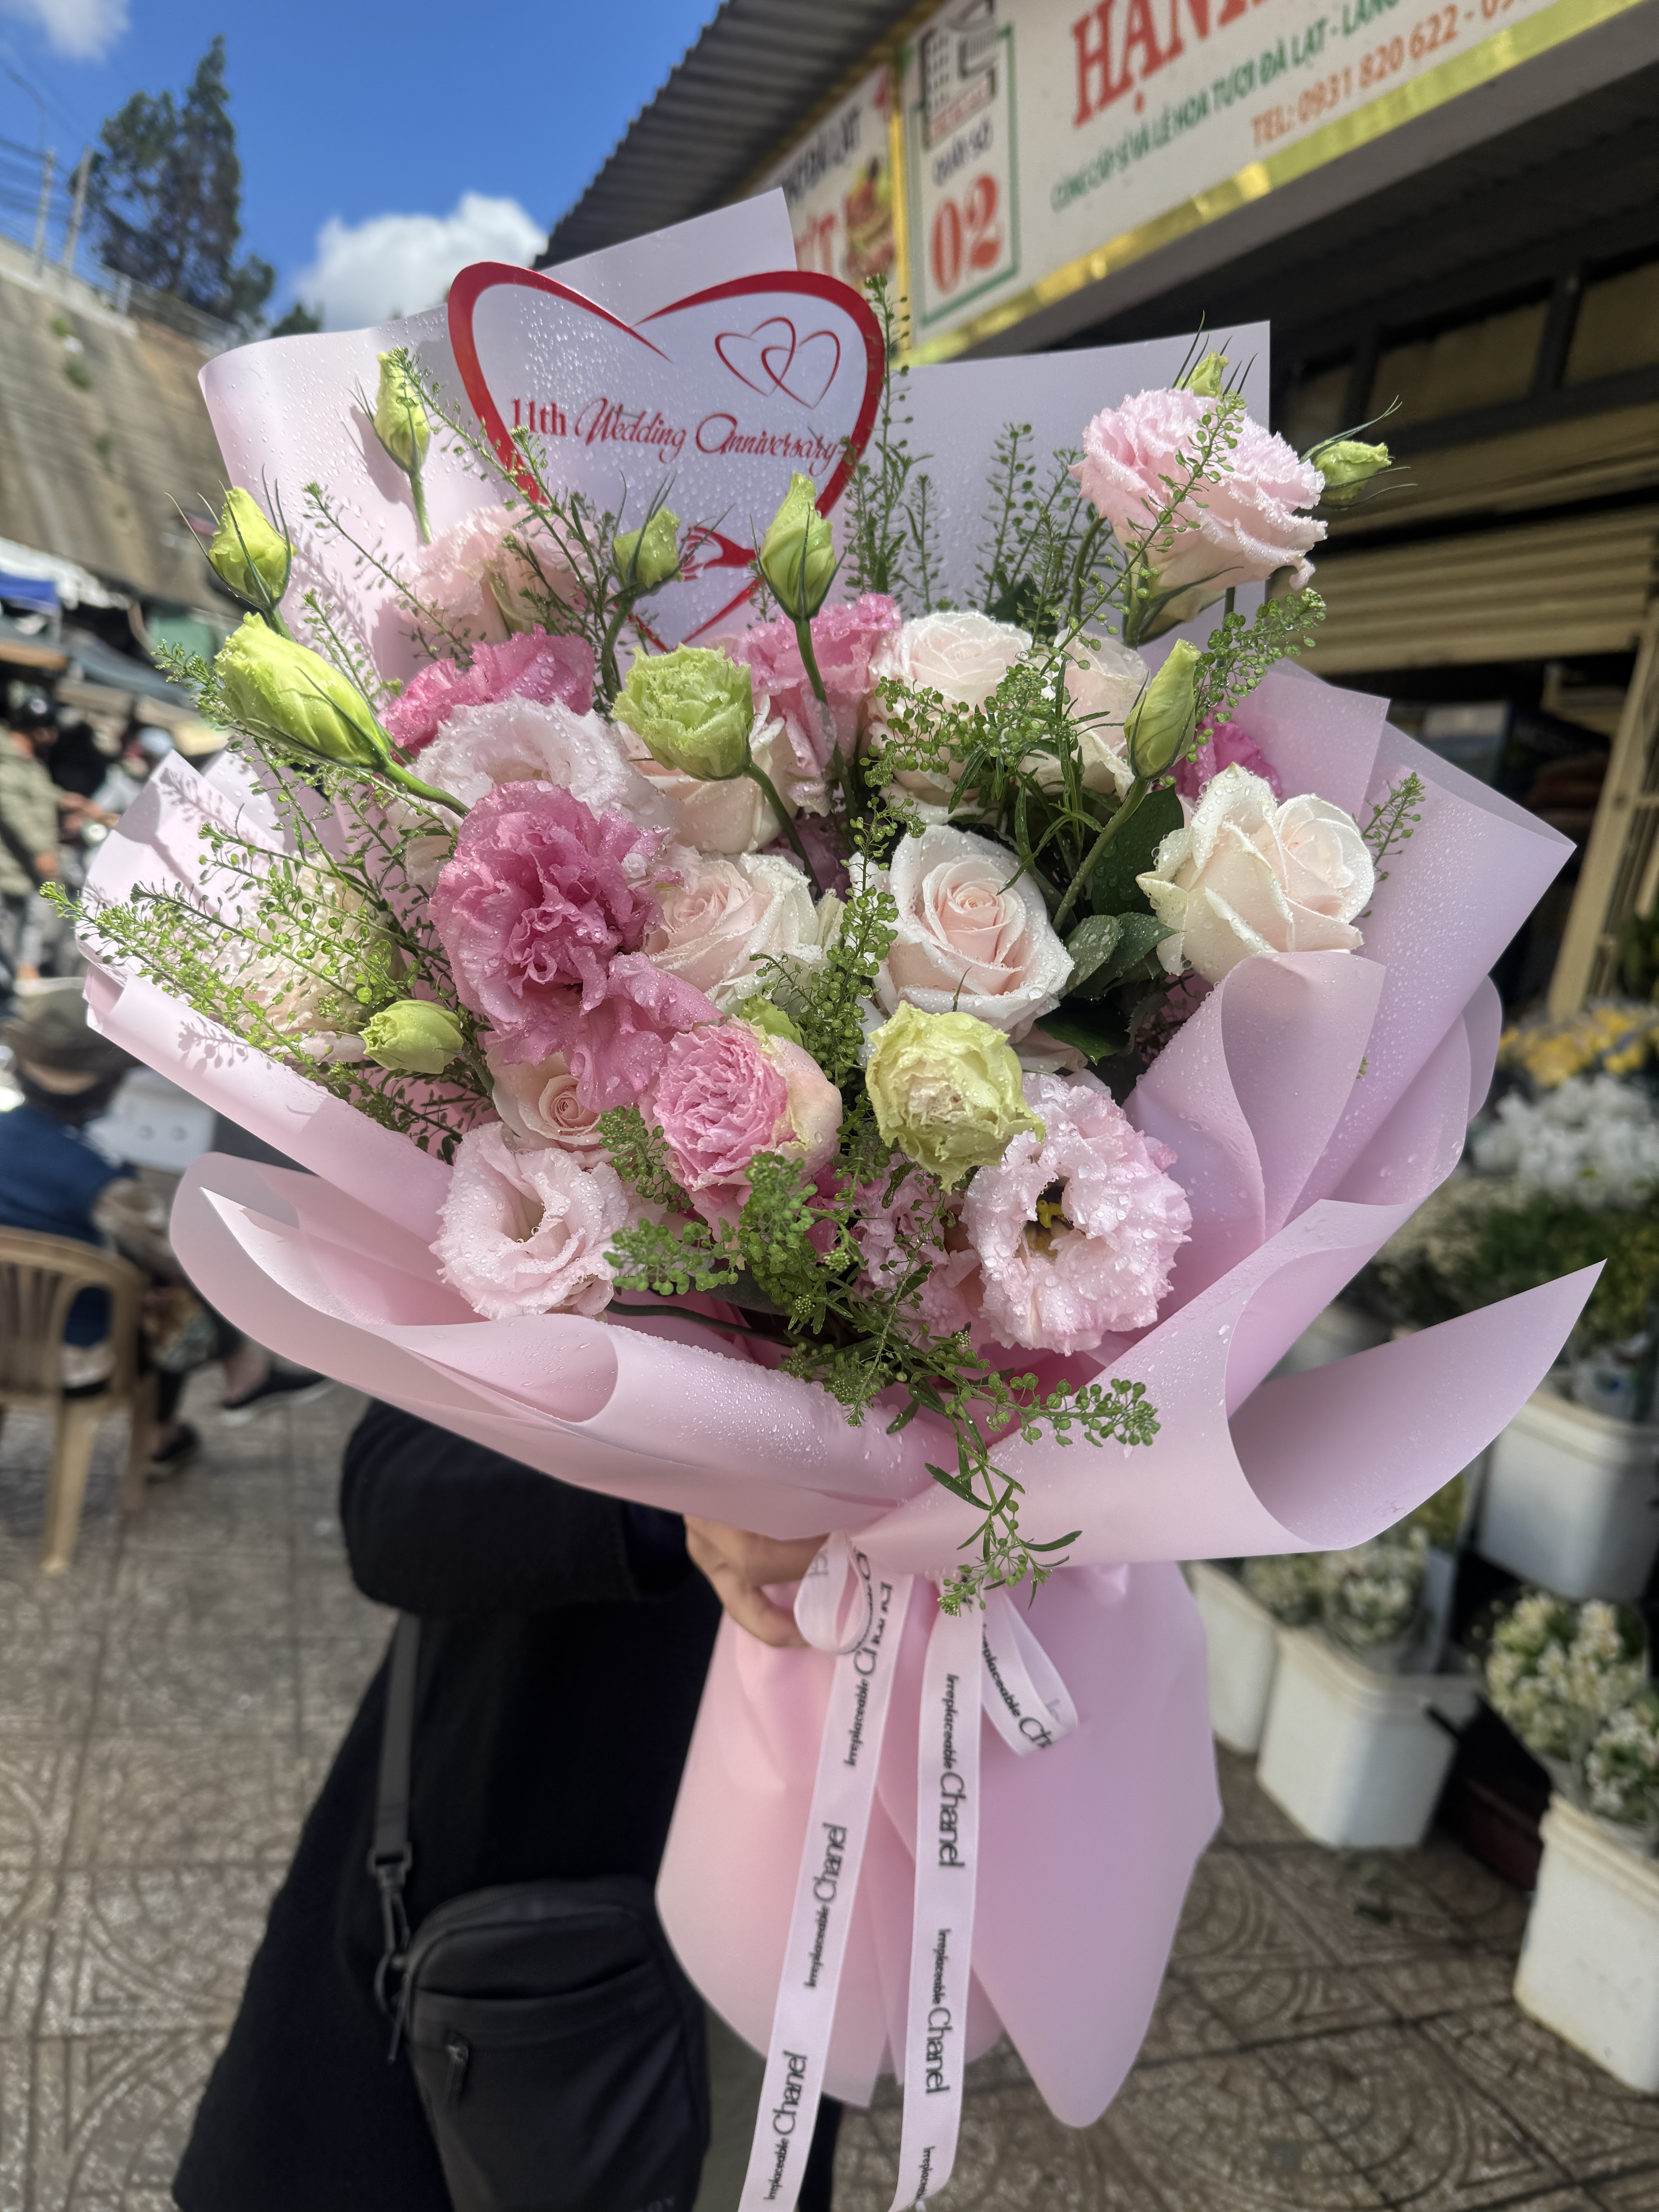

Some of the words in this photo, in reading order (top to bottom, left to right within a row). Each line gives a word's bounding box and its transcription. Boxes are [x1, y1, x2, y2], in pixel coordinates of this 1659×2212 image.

[1072, 0, 1267, 129] HẠN
[1297, 67, 1352, 122] 0931
[1359, 35, 1404, 89] 820
[1410, 4, 1458, 60] 622
[931, 173, 1002, 295] 02
[511, 398, 567, 437] 11th
[574, 397, 686, 464] Wedding
[696, 413, 840, 477] Anniversary
[844, 1678, 870, 1767] Irreplaceable
[942, 1674, 960, 1770] Irreplaceable
[813, 1822, 847, 1903] Chanel
[939, 1771, 967, 1868] Chanel
[804, 1904, 830, 1988] Irreplaceable
[932, 1929, 951, 2005] Irreplaceable
[773, 2051, 807, 2135] Chanel
[926, 2007, 953, 2094] Chanel
[764, 2137, 789, 2200] Irreplaceable
